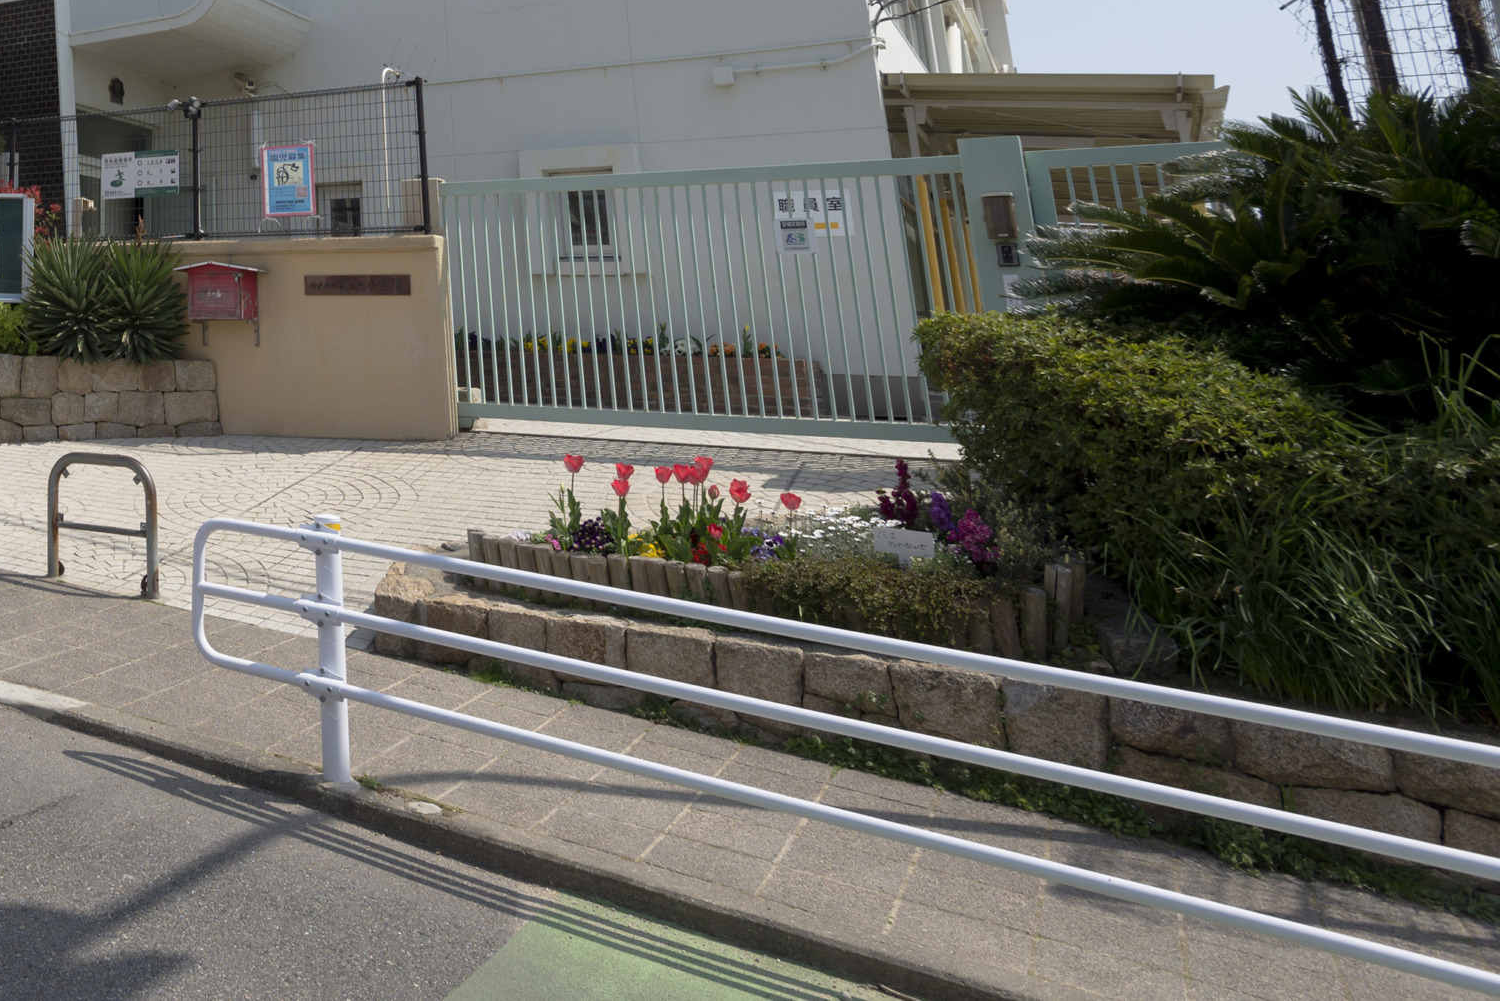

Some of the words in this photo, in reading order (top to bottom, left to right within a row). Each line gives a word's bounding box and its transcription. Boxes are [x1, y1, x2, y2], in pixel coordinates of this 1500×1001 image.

[269, 152, 306, 163] 園児募集
[777, 196, 843, 213] 職員室
